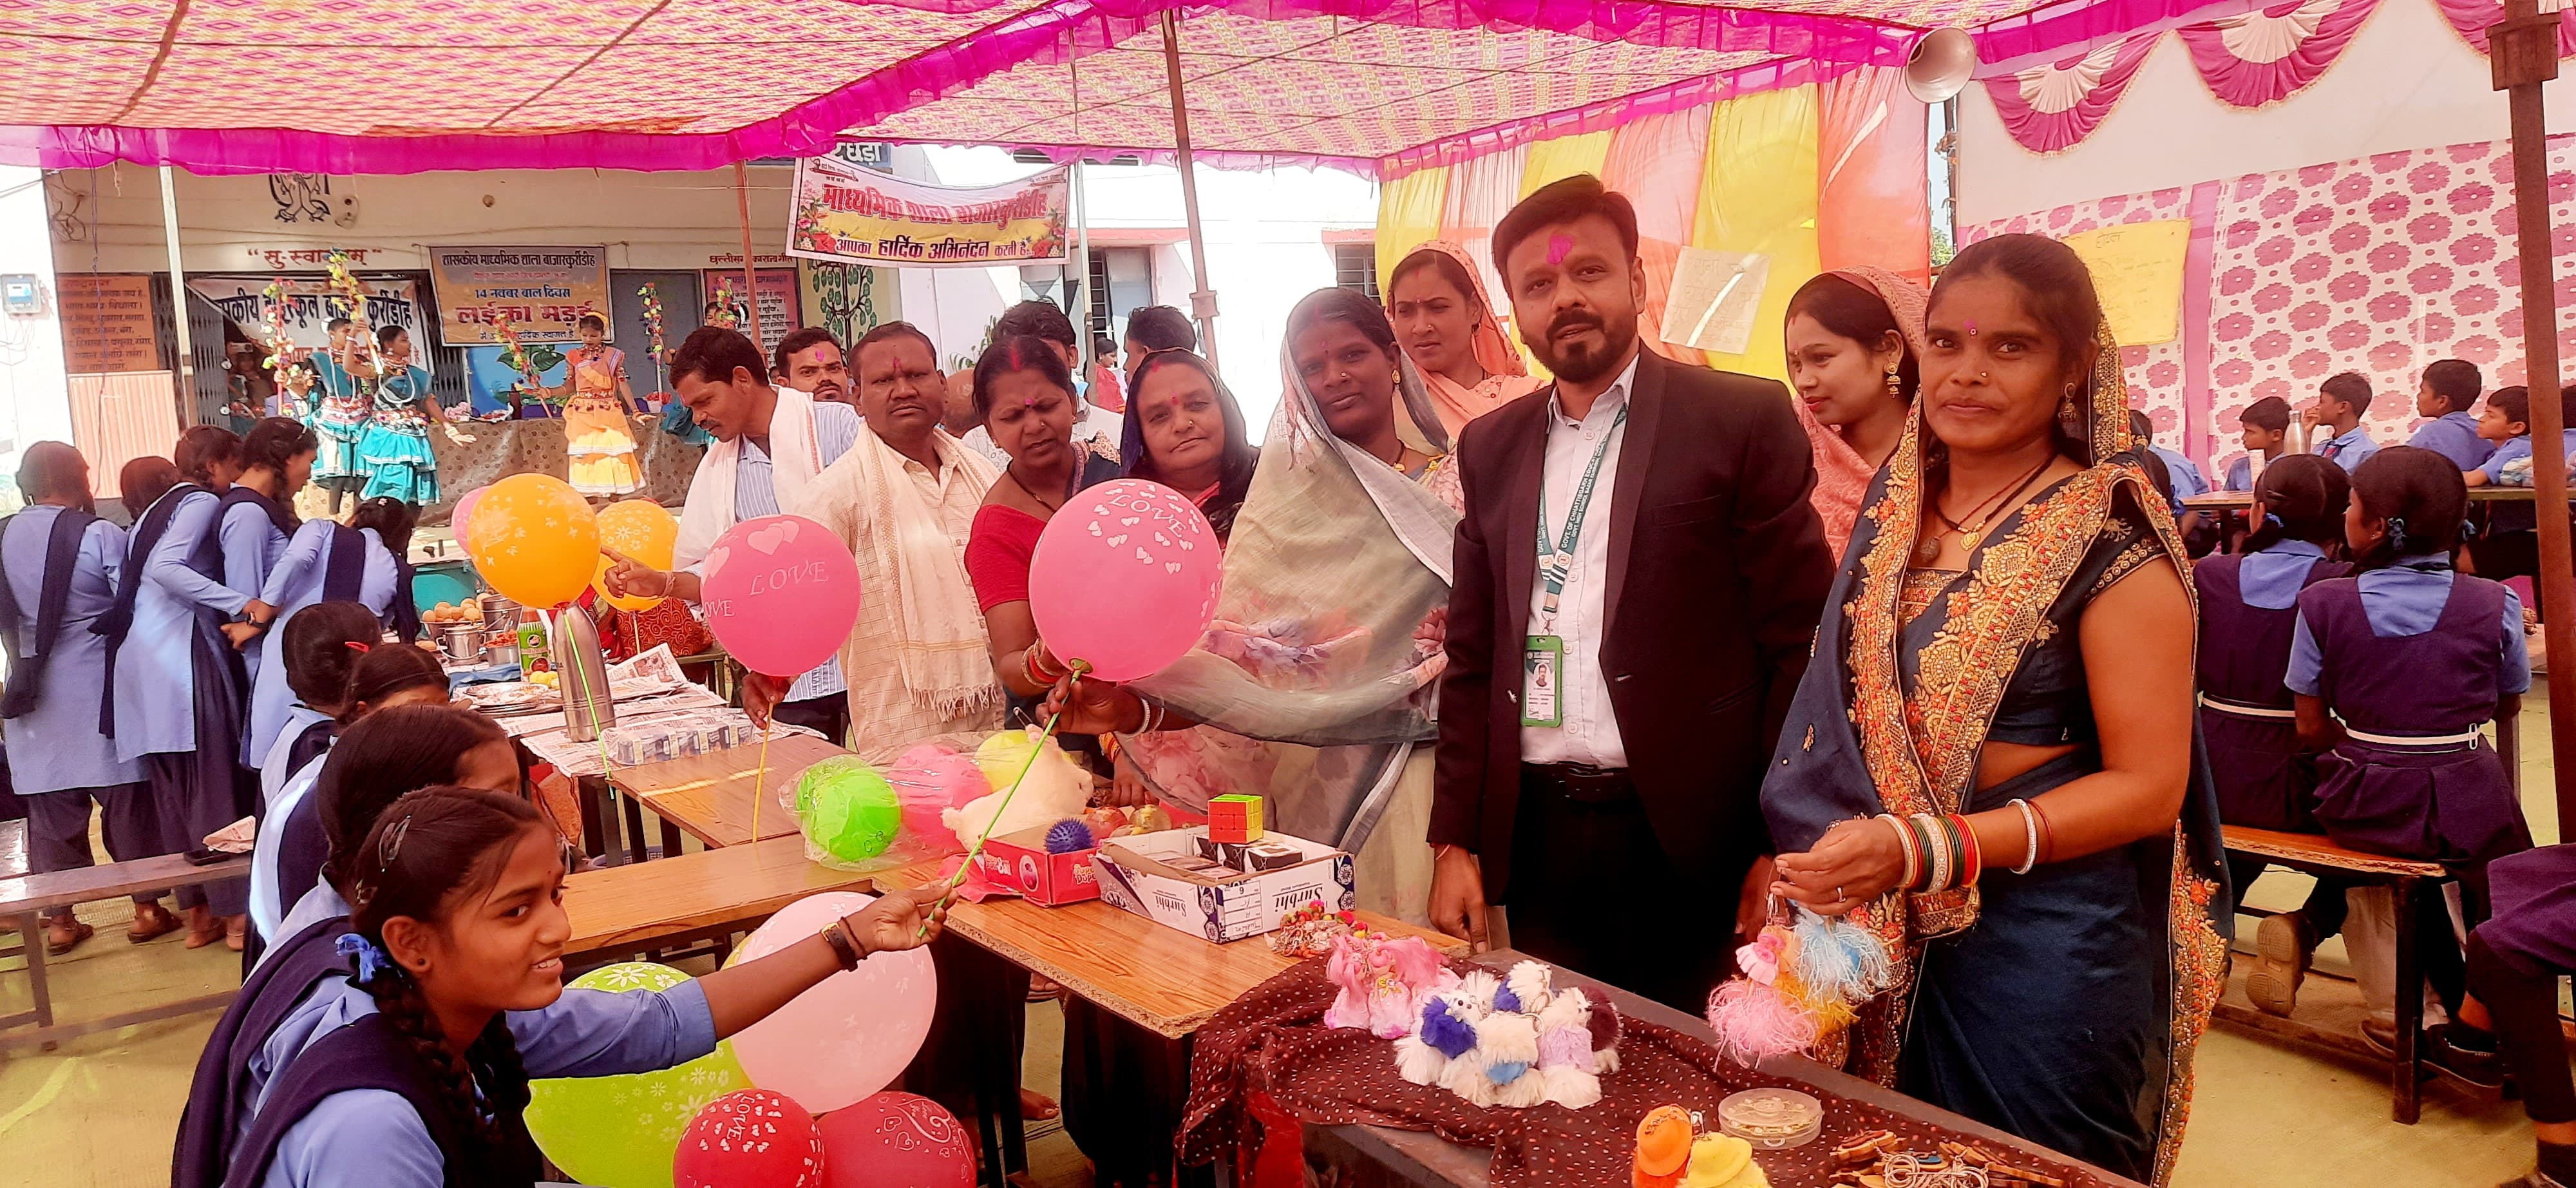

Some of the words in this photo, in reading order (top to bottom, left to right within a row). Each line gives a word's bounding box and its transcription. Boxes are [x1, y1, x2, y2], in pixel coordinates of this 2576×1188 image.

[822, 184, 903, 221] माध्यमिक
[904, 200, 952, 224] शाला
[442, 250, 478, 265] शासकीय
[479, 249, 519, 265] माध्यमिक
[521, 254, 541, 265] शाला
[837, 239, 871, 254] आपका
[878, 235, 925, 258] हार्दिक
[928, 238, 990, 258] अभिनंदन
[994, 240, 1016, 256] करती
[475, 289, 487, 298] 14
[521, 289, 542, 298] बाल
[544, 284, 570, 298] दिवस
[1569, 477, 1588, 521] CHHATTISGARH
[1107, 494, 1187, 538] LOVE
[1566, 522, 1574, 531] OF
[749, 560, 829, 596] LOVE
[703, 599, 735, 618] OVE
[1074, 863, 1095, 875] Supe
[1076, 873, 1096, 885] Dupe
[1155, 895, 1186, 917] Surbhi
[1274, 886, 1323, 912] Surbhi
[726, 1095, 755, 1141] LOVE
